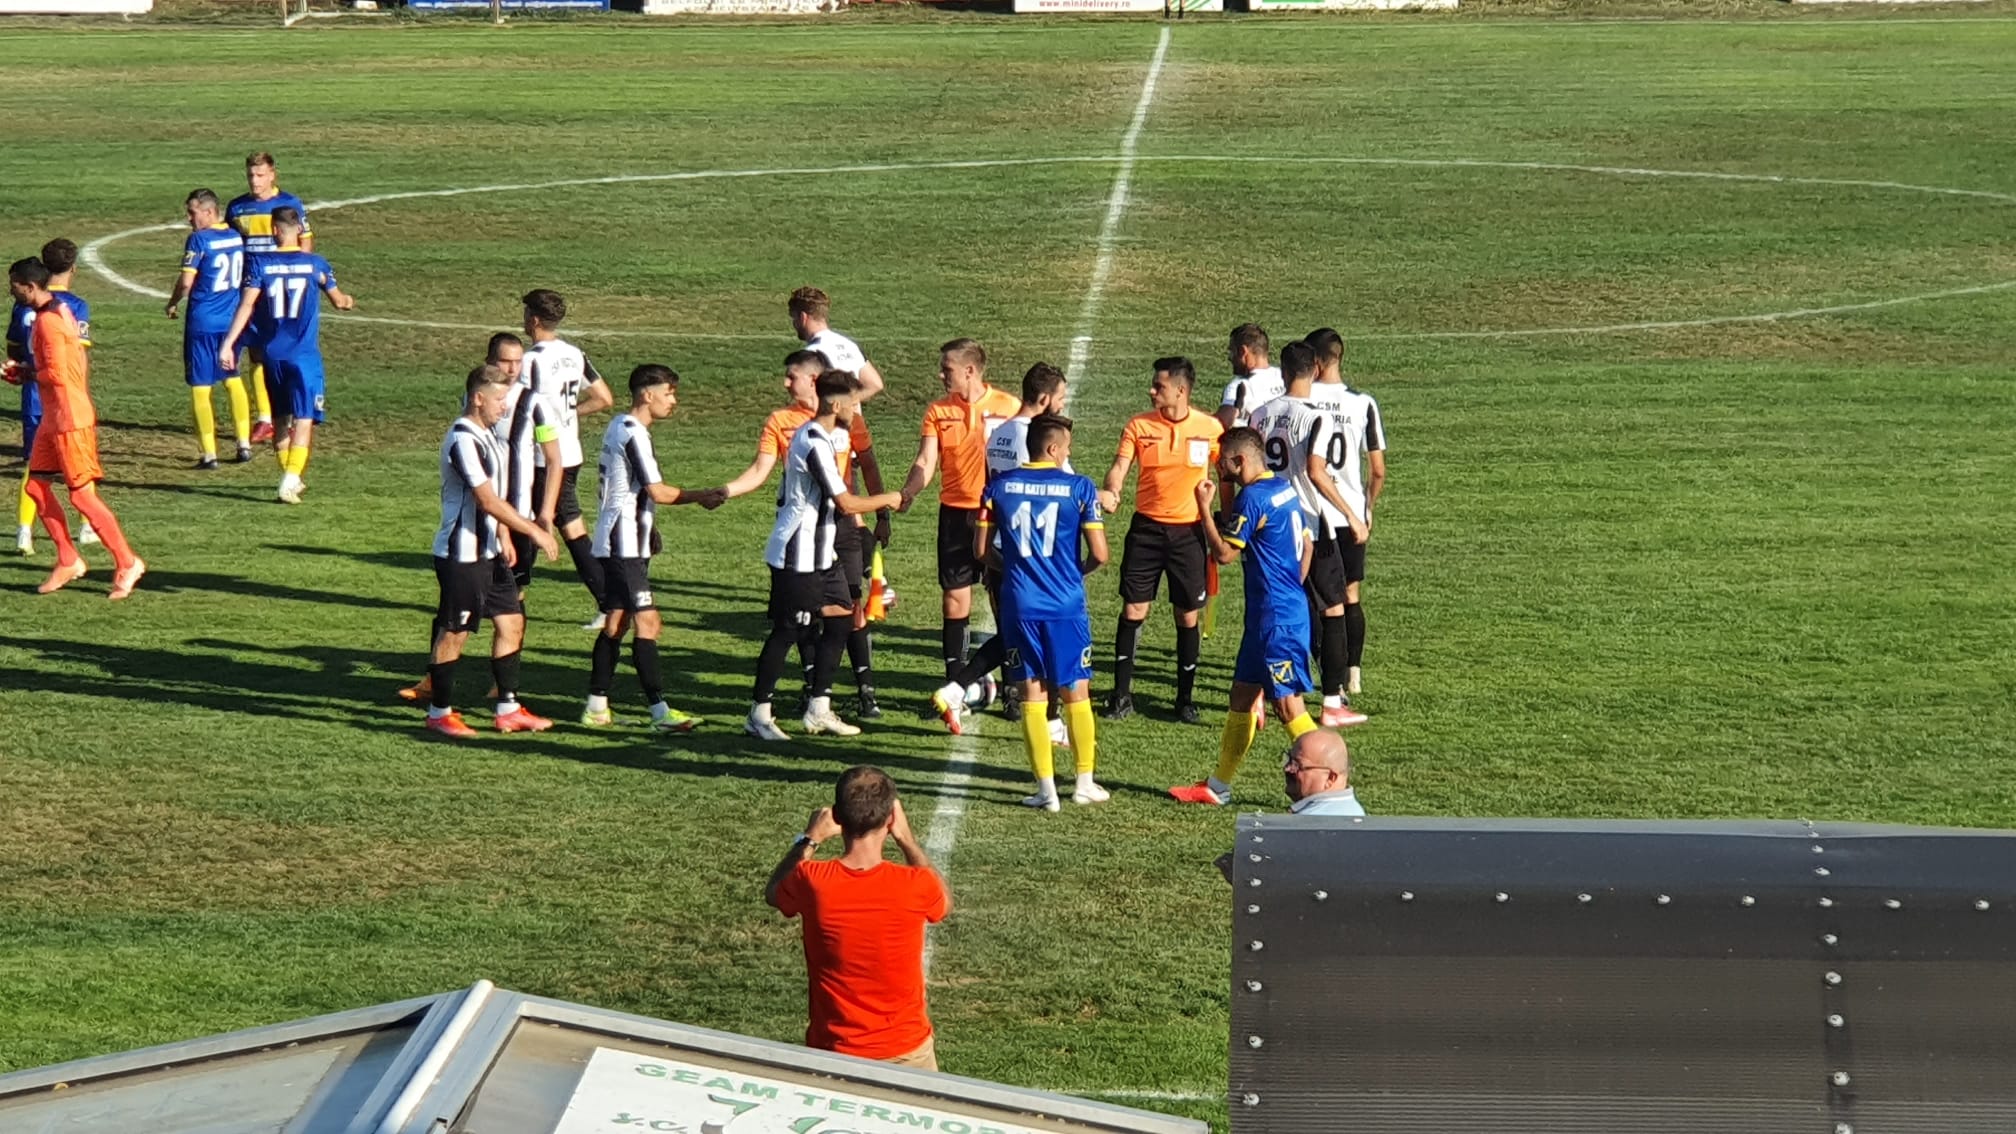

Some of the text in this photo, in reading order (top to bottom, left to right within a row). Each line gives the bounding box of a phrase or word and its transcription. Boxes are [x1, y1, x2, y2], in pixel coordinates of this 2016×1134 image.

[213, 250, 244, 292] 20
[268, 277, 307, 318] 17
[560, 380, 579, 413] 15
[1317, 402, 1341, 411] CSM
[1005, 482, 1024, 494] CSM
[1025, 483, 1046, 496] SATU
[1012, 501, 1059, 558] 11
[636, 591, 652, 607] 25
[460, 610, 471, 625] 7
[635, 1063, 779, 1099] GEAM
